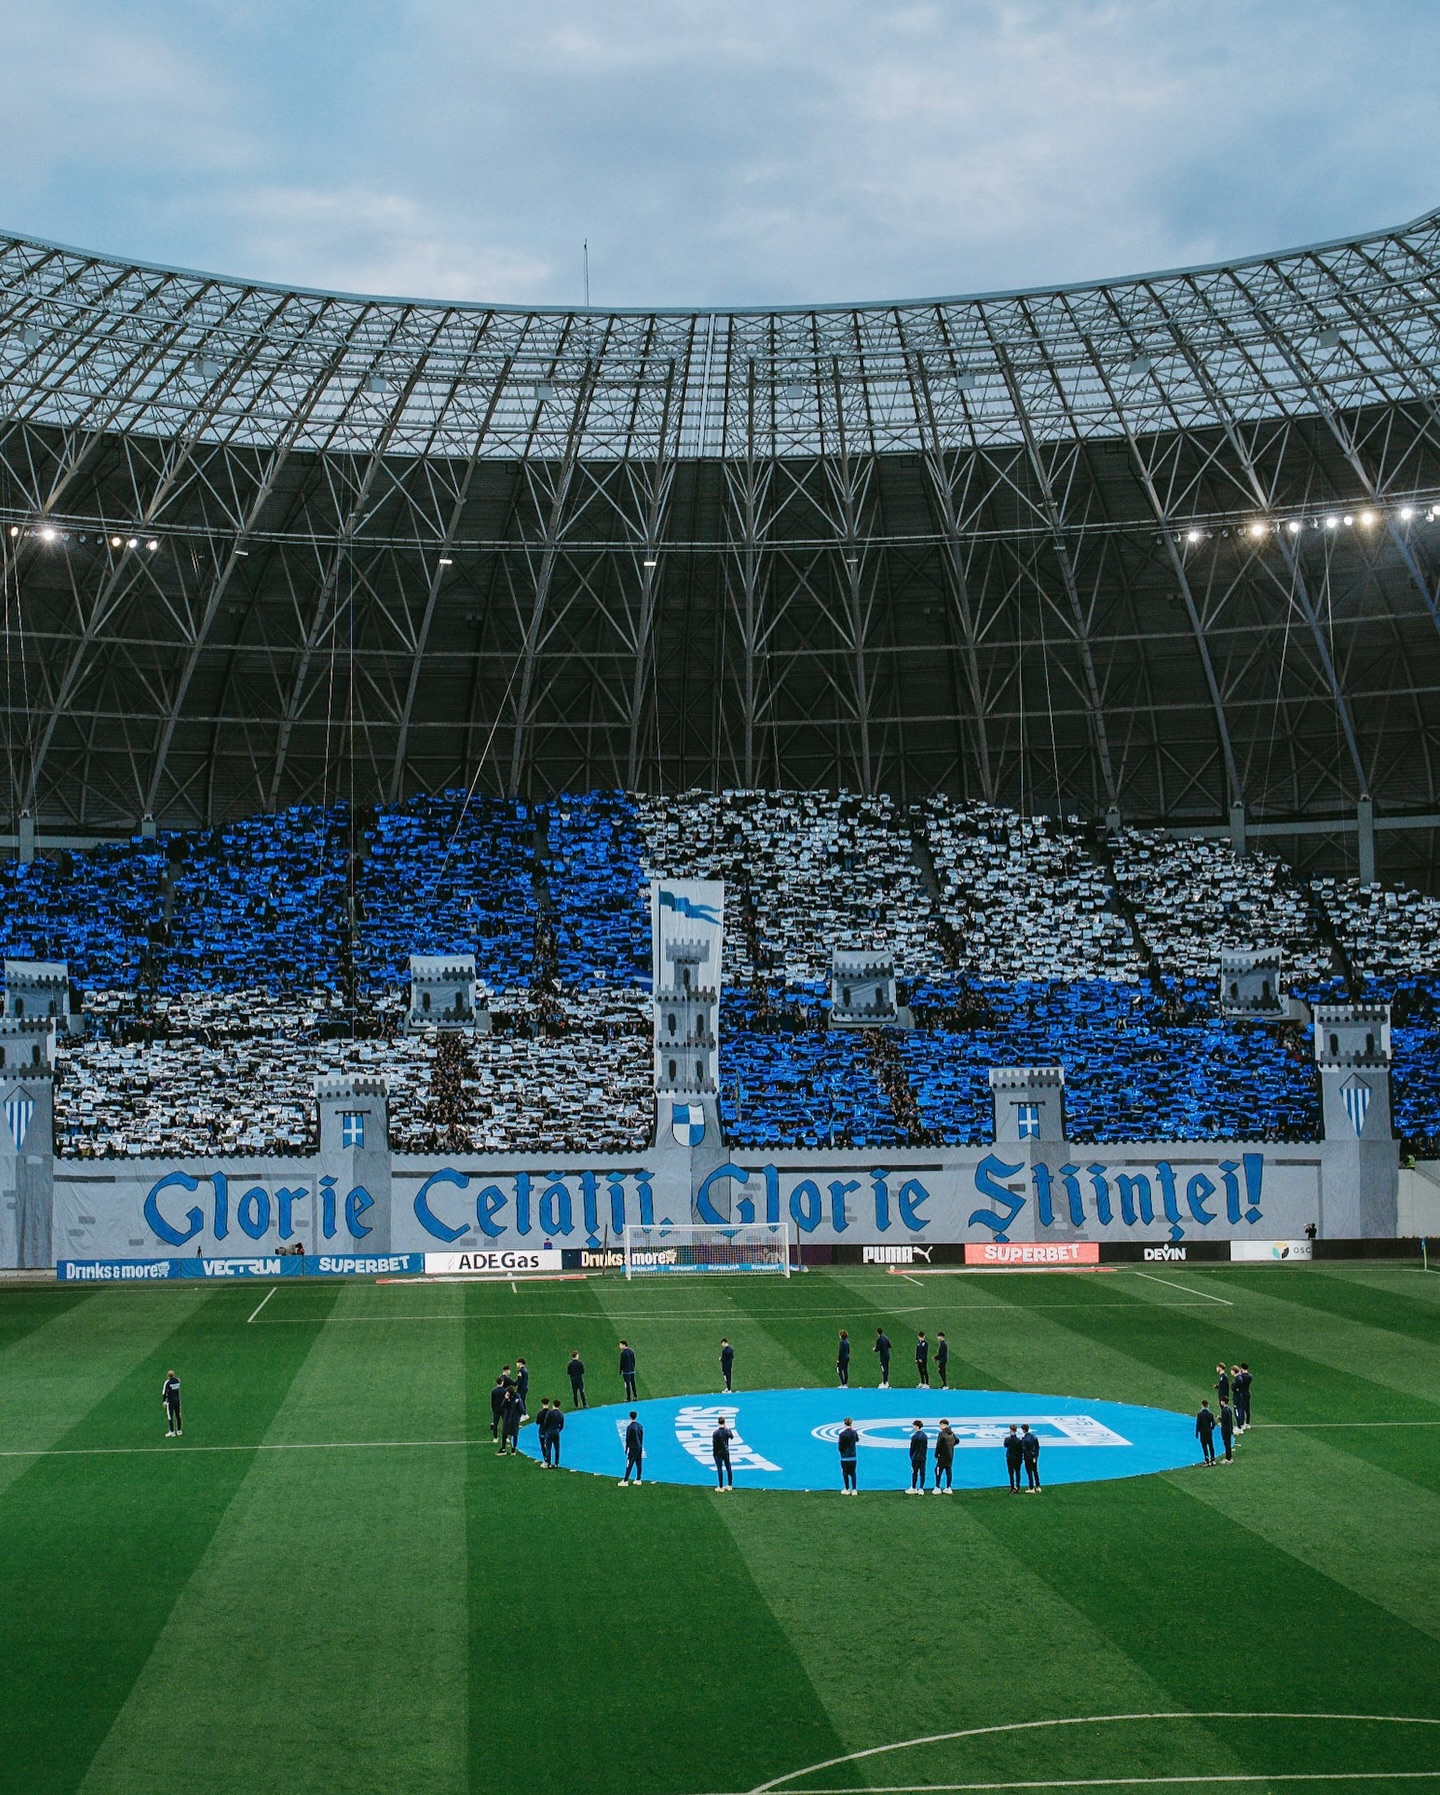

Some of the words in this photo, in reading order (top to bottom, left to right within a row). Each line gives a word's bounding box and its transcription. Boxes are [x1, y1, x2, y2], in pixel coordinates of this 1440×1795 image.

[144, 1170, 375, 1247] Glorie
[696, 1162, 932, 1238] Glorie
[458, 1252, 539, 1270] ADEGas
[862, 1246, 914, 1263] PUMA
[984, 1244, 1079, 1262] SUPERBET
[1144, 1246, 1187, 1261] DEVIN
[202, 1259, 281, 1276] VECTRUM
[318, 1255, 410, 1273] SUPERBET
